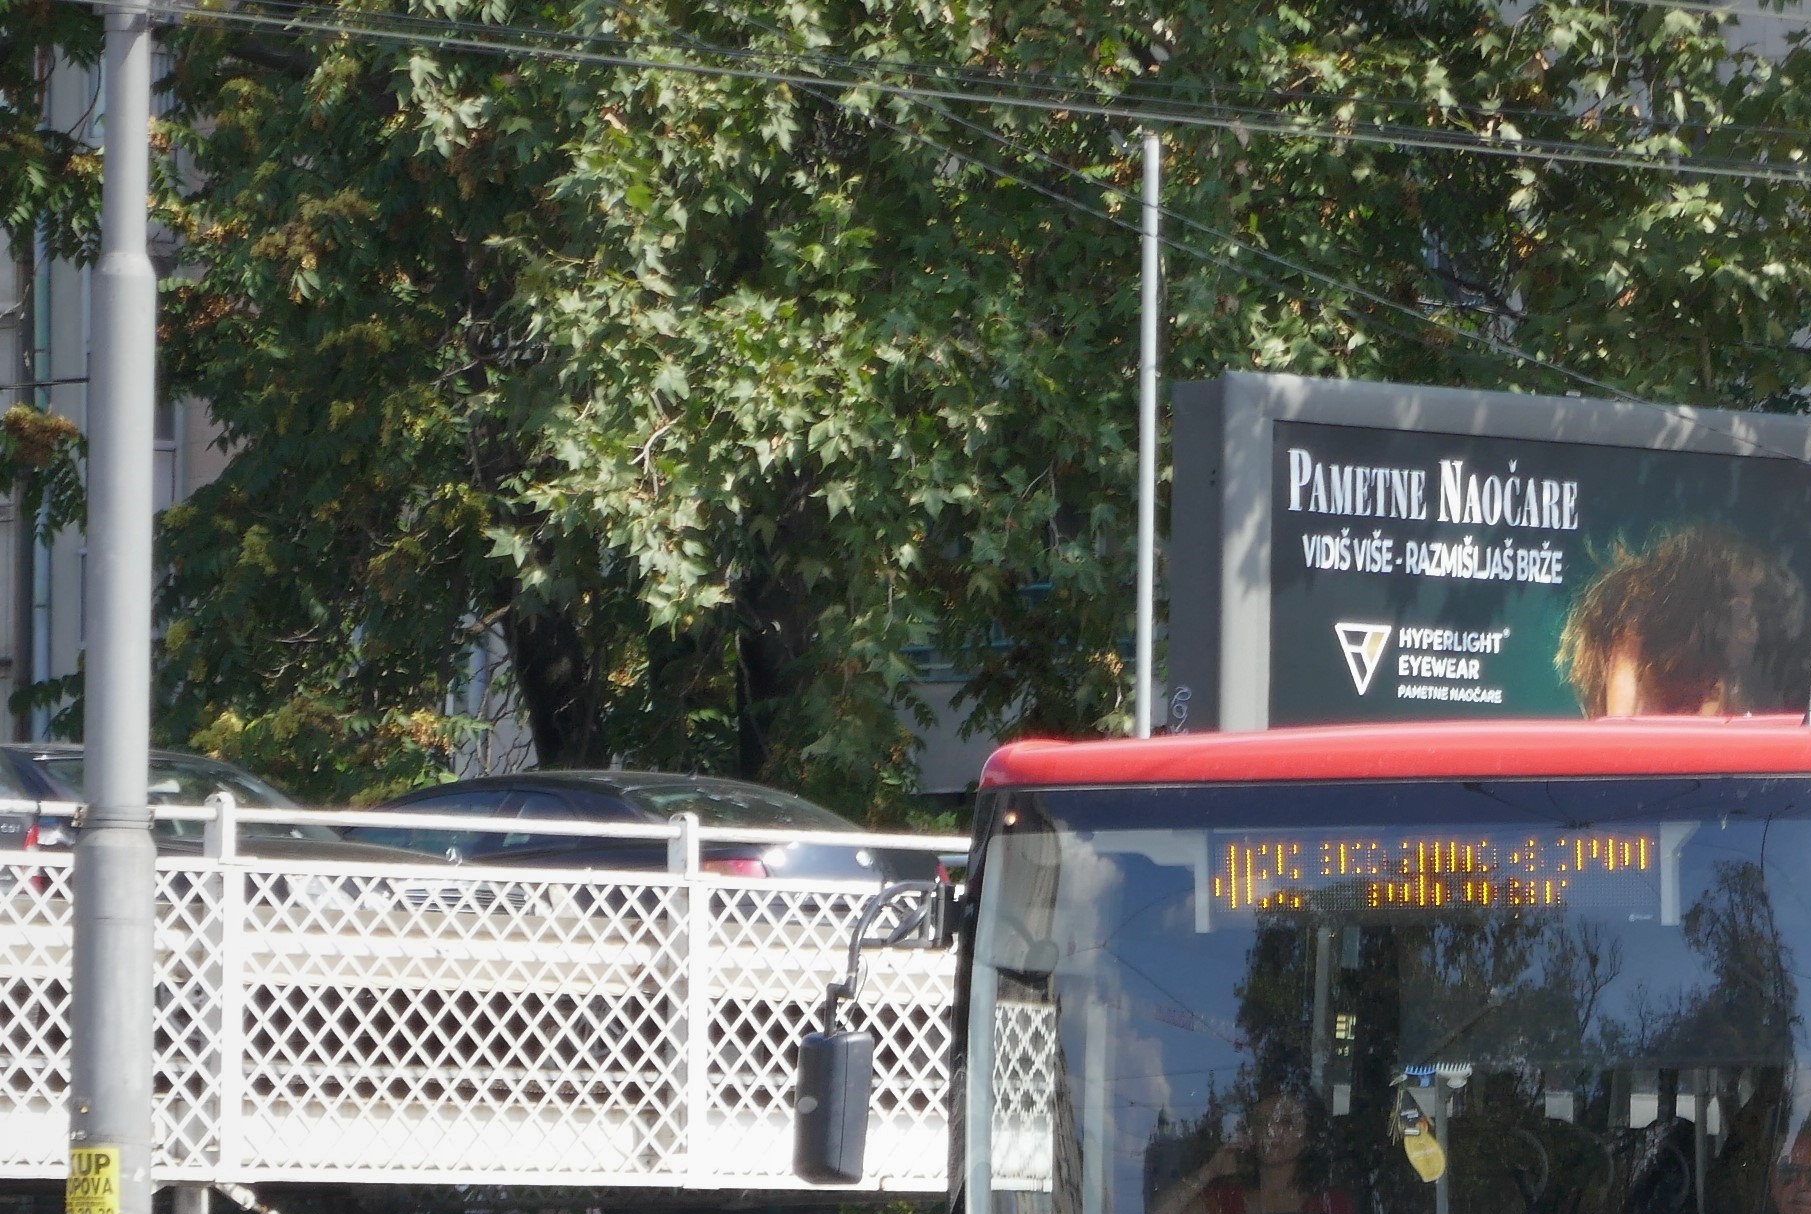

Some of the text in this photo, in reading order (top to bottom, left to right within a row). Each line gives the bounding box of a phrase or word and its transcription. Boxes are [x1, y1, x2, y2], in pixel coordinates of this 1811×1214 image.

[1288, 448, 1579, 530] PAMETNE NAOČARE
[1302, 527, 1350, 571] VIDIŠ
[1353, 529, 1393, 573] VIŠE
[1405, 535, 1513, 580] RAZMIŠLJAŠ
[1516, 540, 1562, 584] BRŽE
[1398, 655, 1480, 680] EYEWEAR
[1397, 685, 1449, 701] PAMETNE
